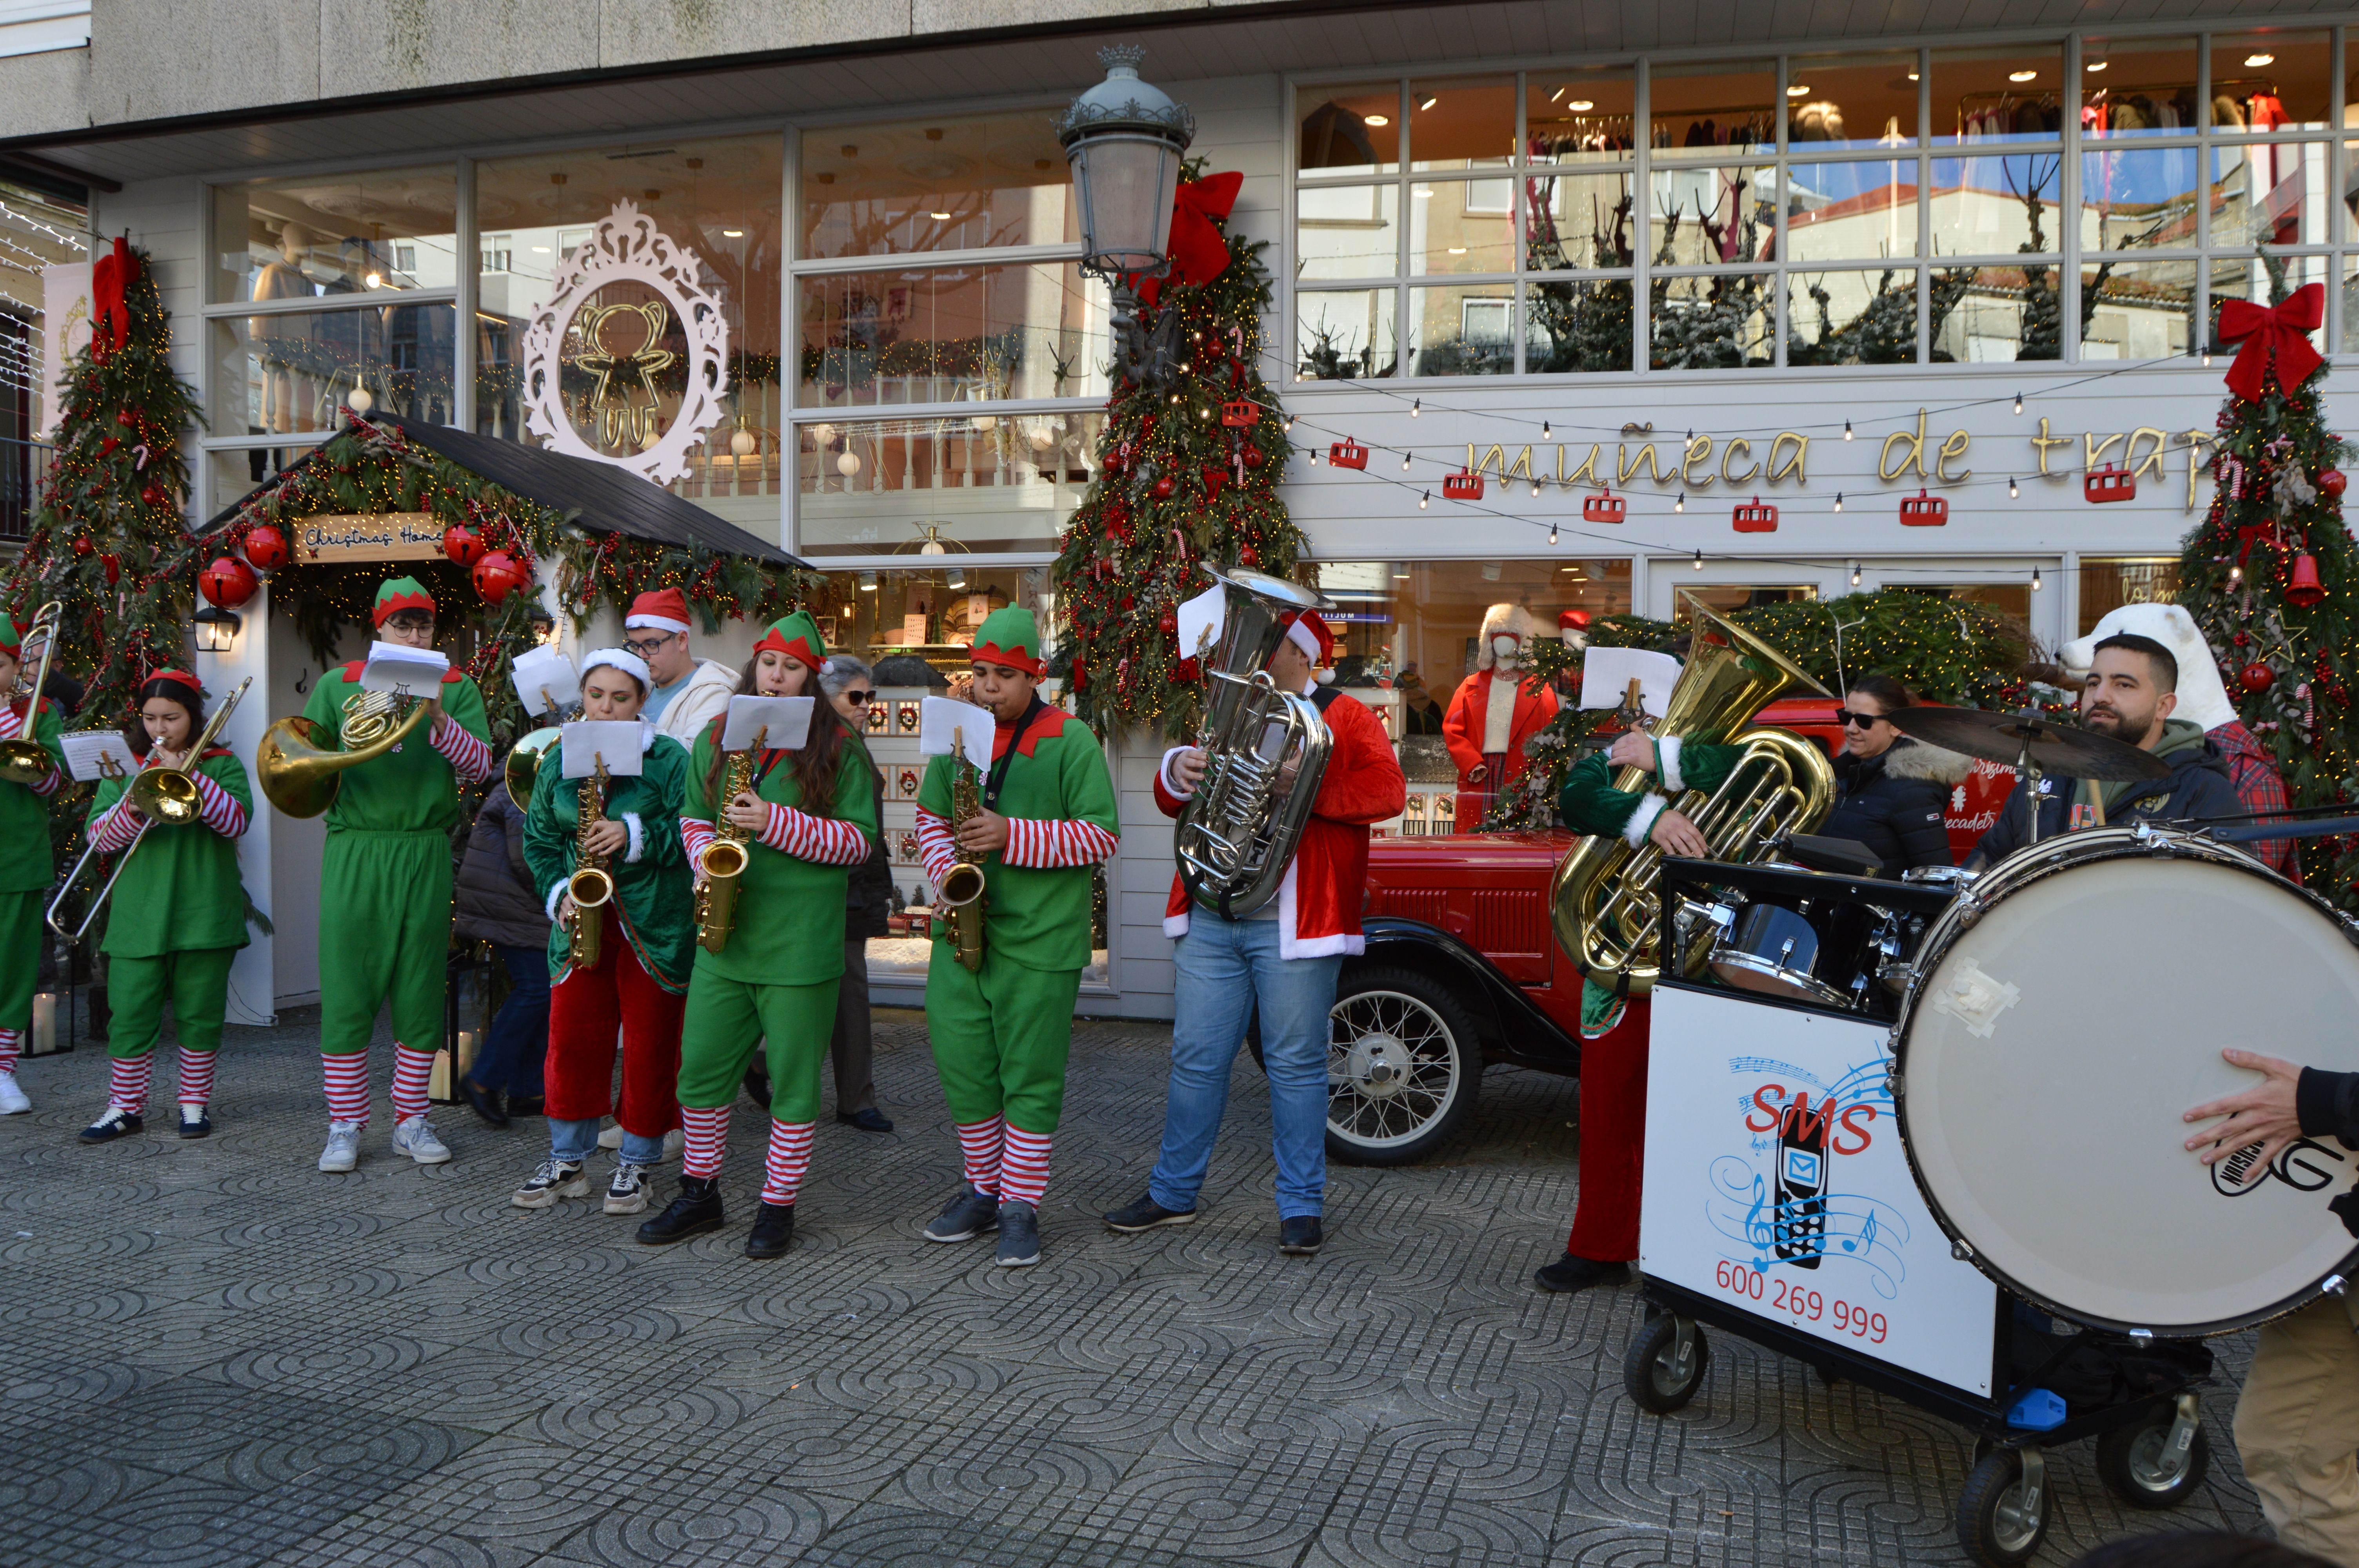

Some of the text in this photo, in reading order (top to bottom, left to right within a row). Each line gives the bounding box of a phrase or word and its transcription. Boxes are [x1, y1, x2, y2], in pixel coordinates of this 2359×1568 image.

[1467, 407, 2222, 515] muñeca de trap
[305, 524, 442, 548] Christmas Home
[2122, 577, 2147, 605] la
[1745, 1084, 1877, 1156] SMS
[1717, 1260, 1887, 1344] 600 269 999
